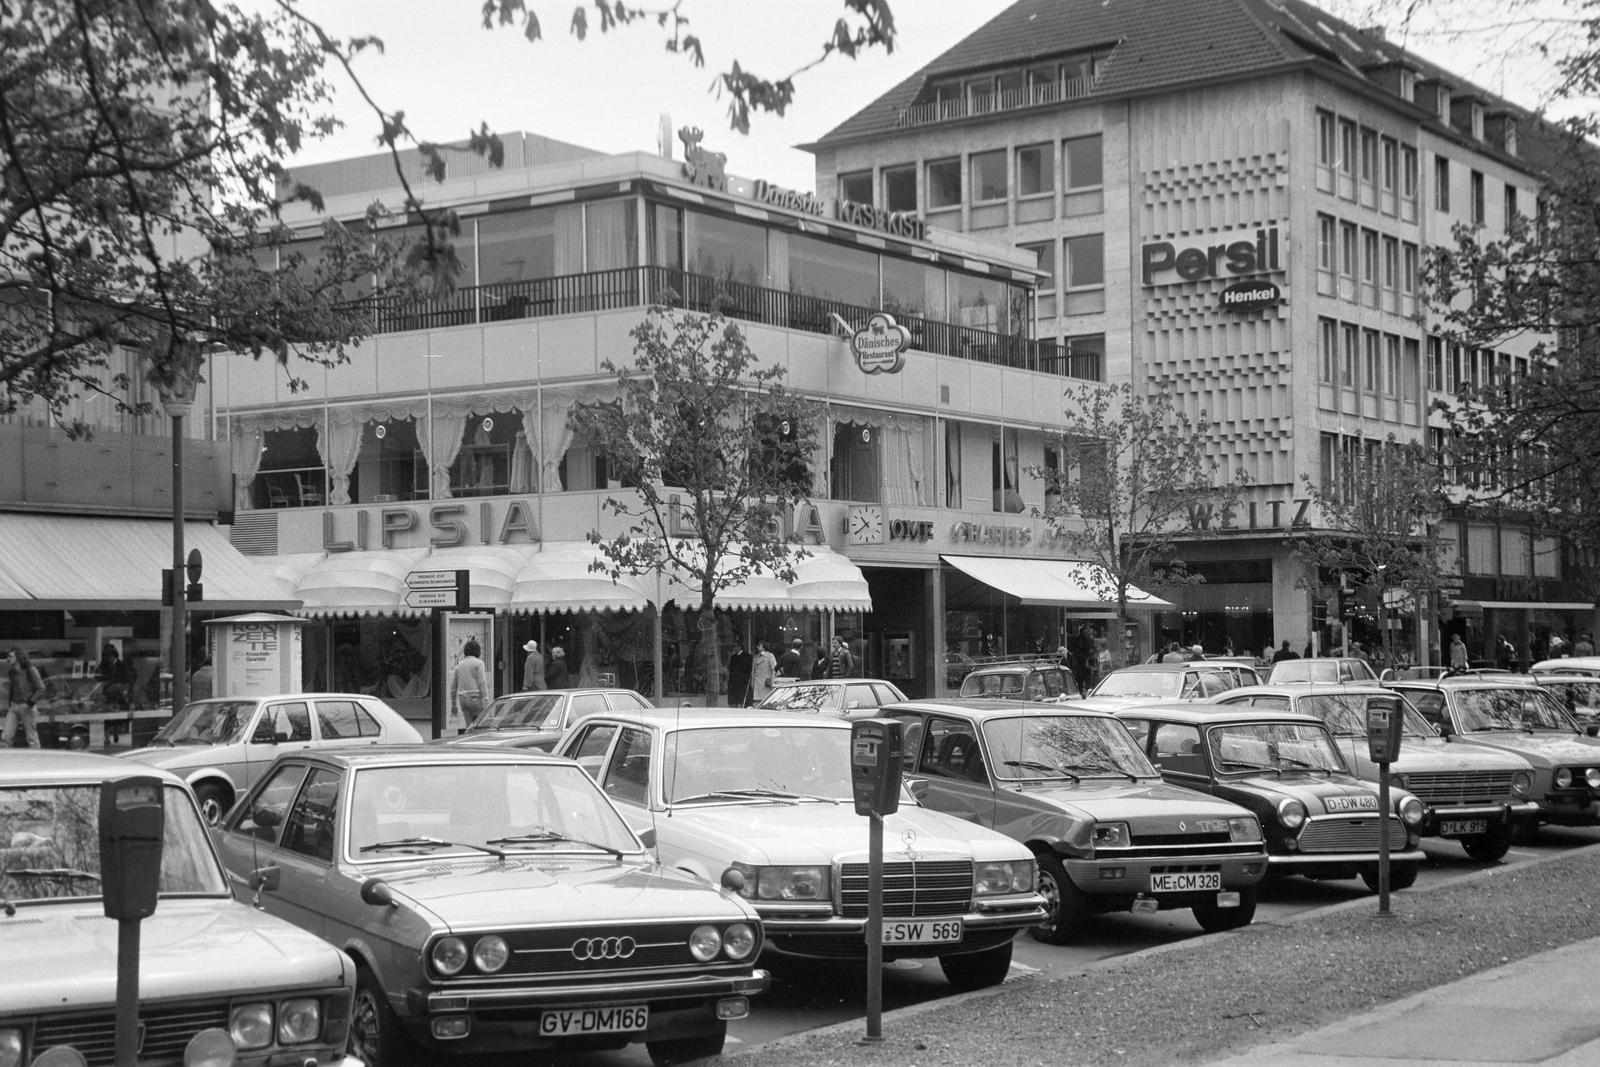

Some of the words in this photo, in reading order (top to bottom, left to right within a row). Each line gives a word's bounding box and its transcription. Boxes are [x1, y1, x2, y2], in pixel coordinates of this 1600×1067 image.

[1142, 227, 1281, 285] Persil
[1224, 287, 1275, 303] Henkel
[858, 335, 900, 349] Dänisches
[862, 350, 895, 360] Restaurant
[669, 493, 826, 544] LPSIA
[1188, 498, 1312, 531] WEITZ
[322, 499, 541, 552] LIPSIA
[232, 631, 278, 642] ZER
[246, 641, 278, 651] TE
[1327, 797, 1358, 810] D-DW
[1360, 797, 1377, 808] 480
[1152, 875, 1197, 890] ME-CM
[1198, 874, 1219, 889] 328
[932, 922, 960, 940] 569
